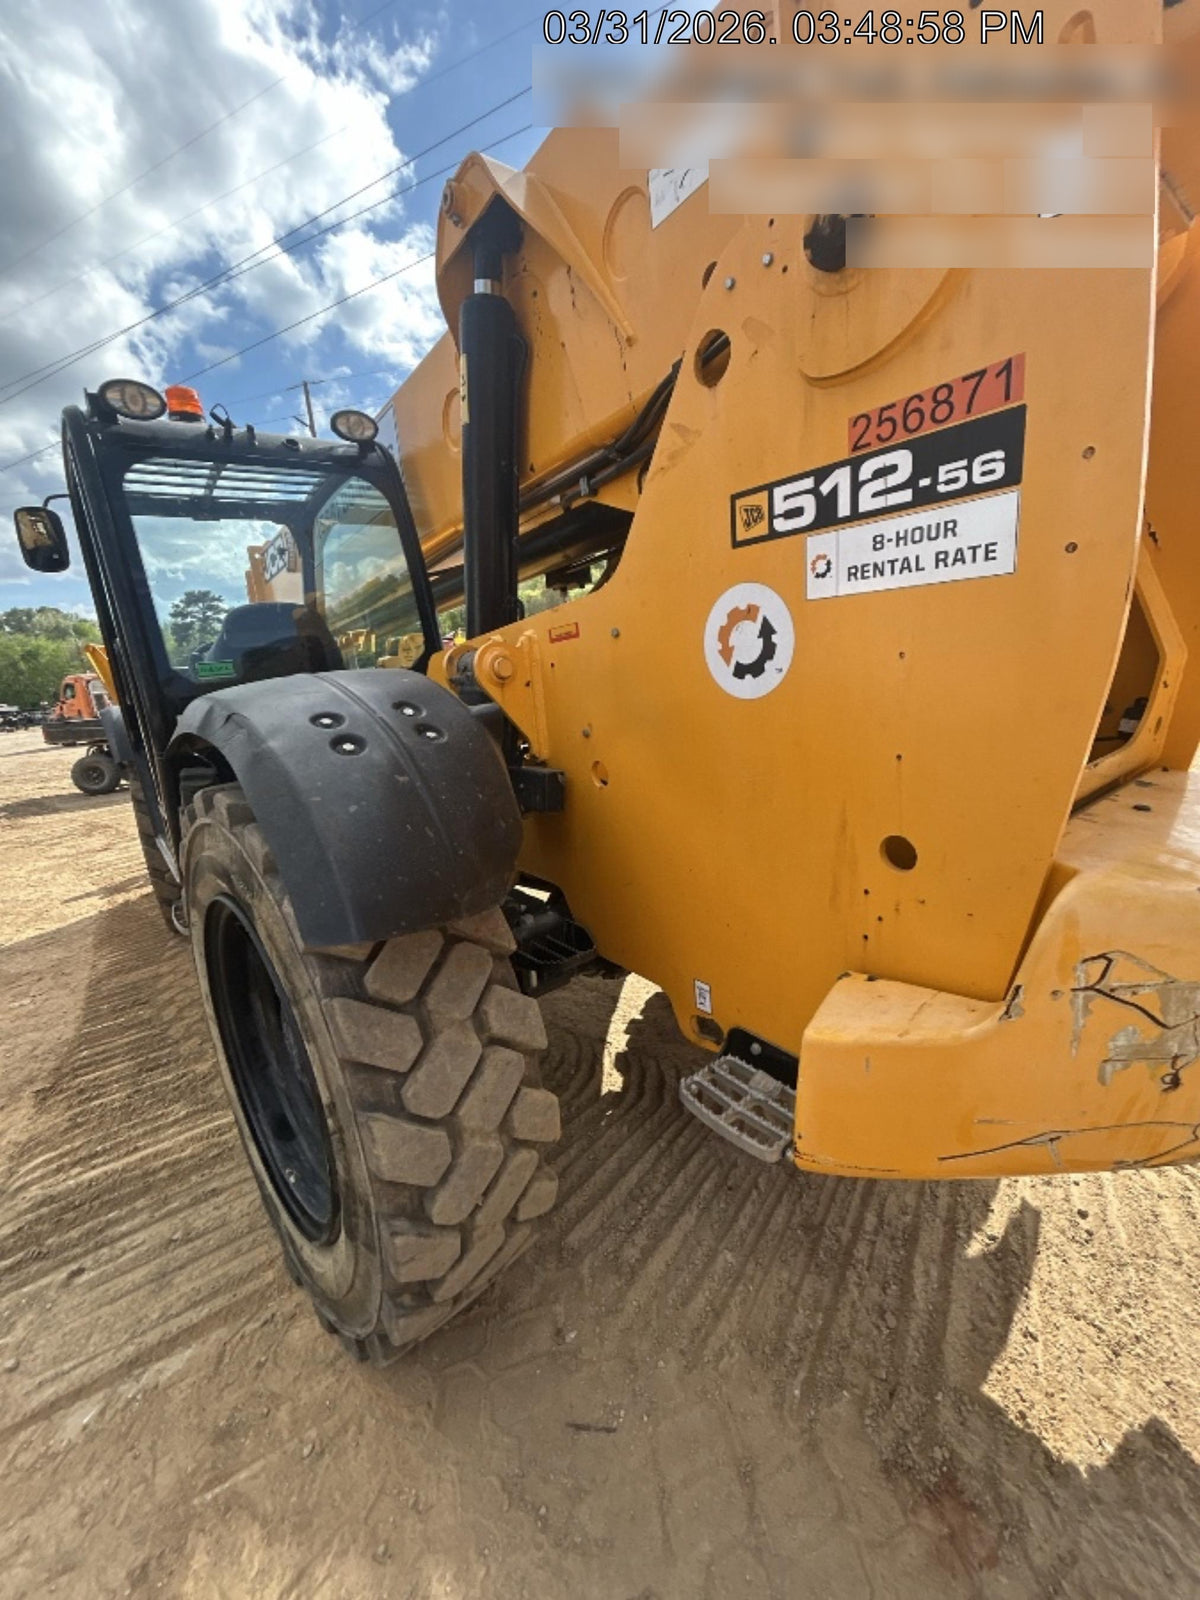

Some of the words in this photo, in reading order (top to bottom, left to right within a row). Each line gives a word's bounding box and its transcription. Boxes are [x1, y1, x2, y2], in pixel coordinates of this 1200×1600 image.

[851, 357, 1014, 452] 256871
[772, 449, 1006, 533] 512-56
[847, 554, 926, 582] RENTAL
[935, 542, 998, 569] RATE
[872, 519, 958, 551] 8-HOUR
